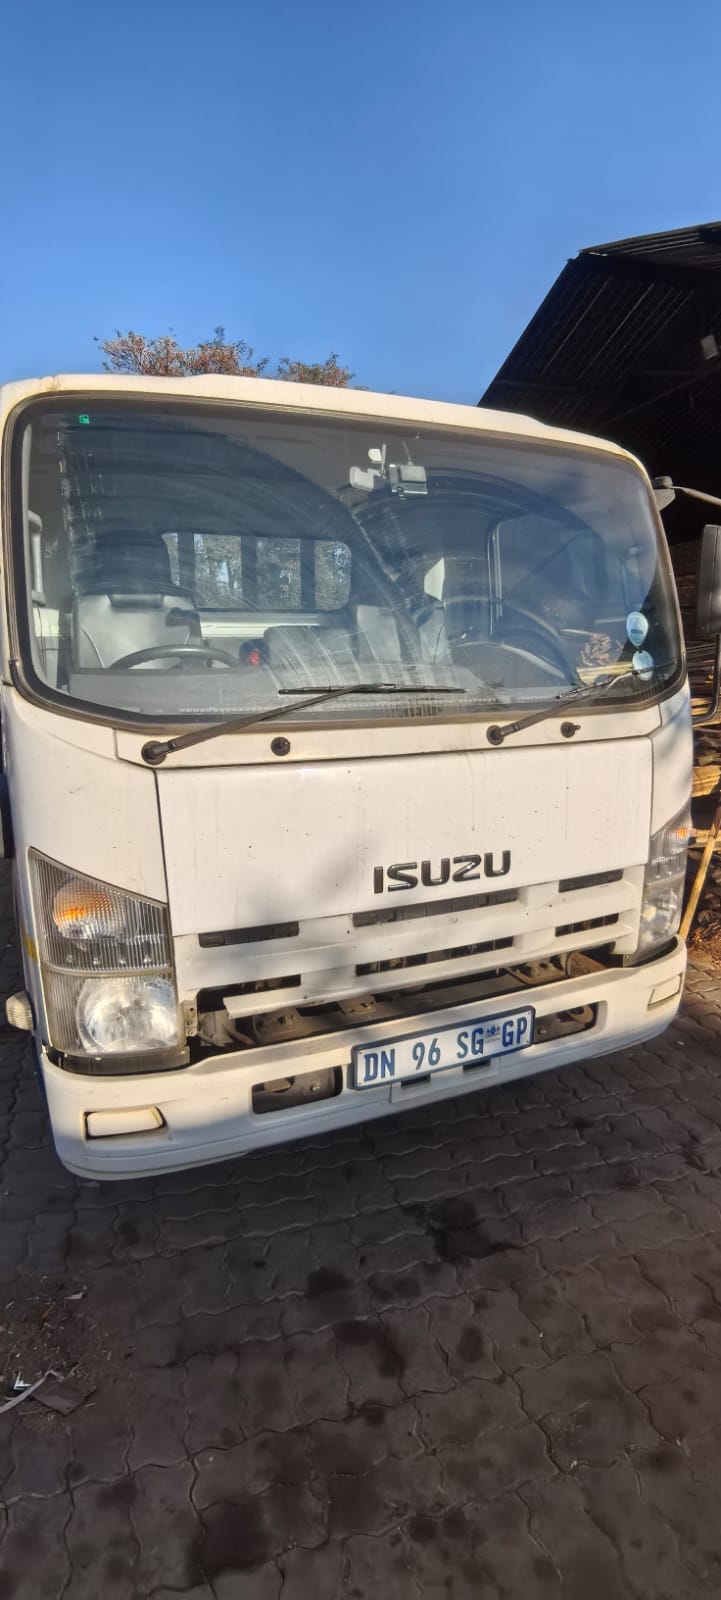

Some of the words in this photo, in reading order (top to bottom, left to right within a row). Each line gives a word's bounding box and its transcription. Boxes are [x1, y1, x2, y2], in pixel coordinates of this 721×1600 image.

[374, 850, 511, 894] ISUZU
[364, 1049, 395, 1082] DN
[412, 1038, 441, 1070] 96
[457, 1027, 484, 1059] SG
[502, 1017, 528, 1048] GP
